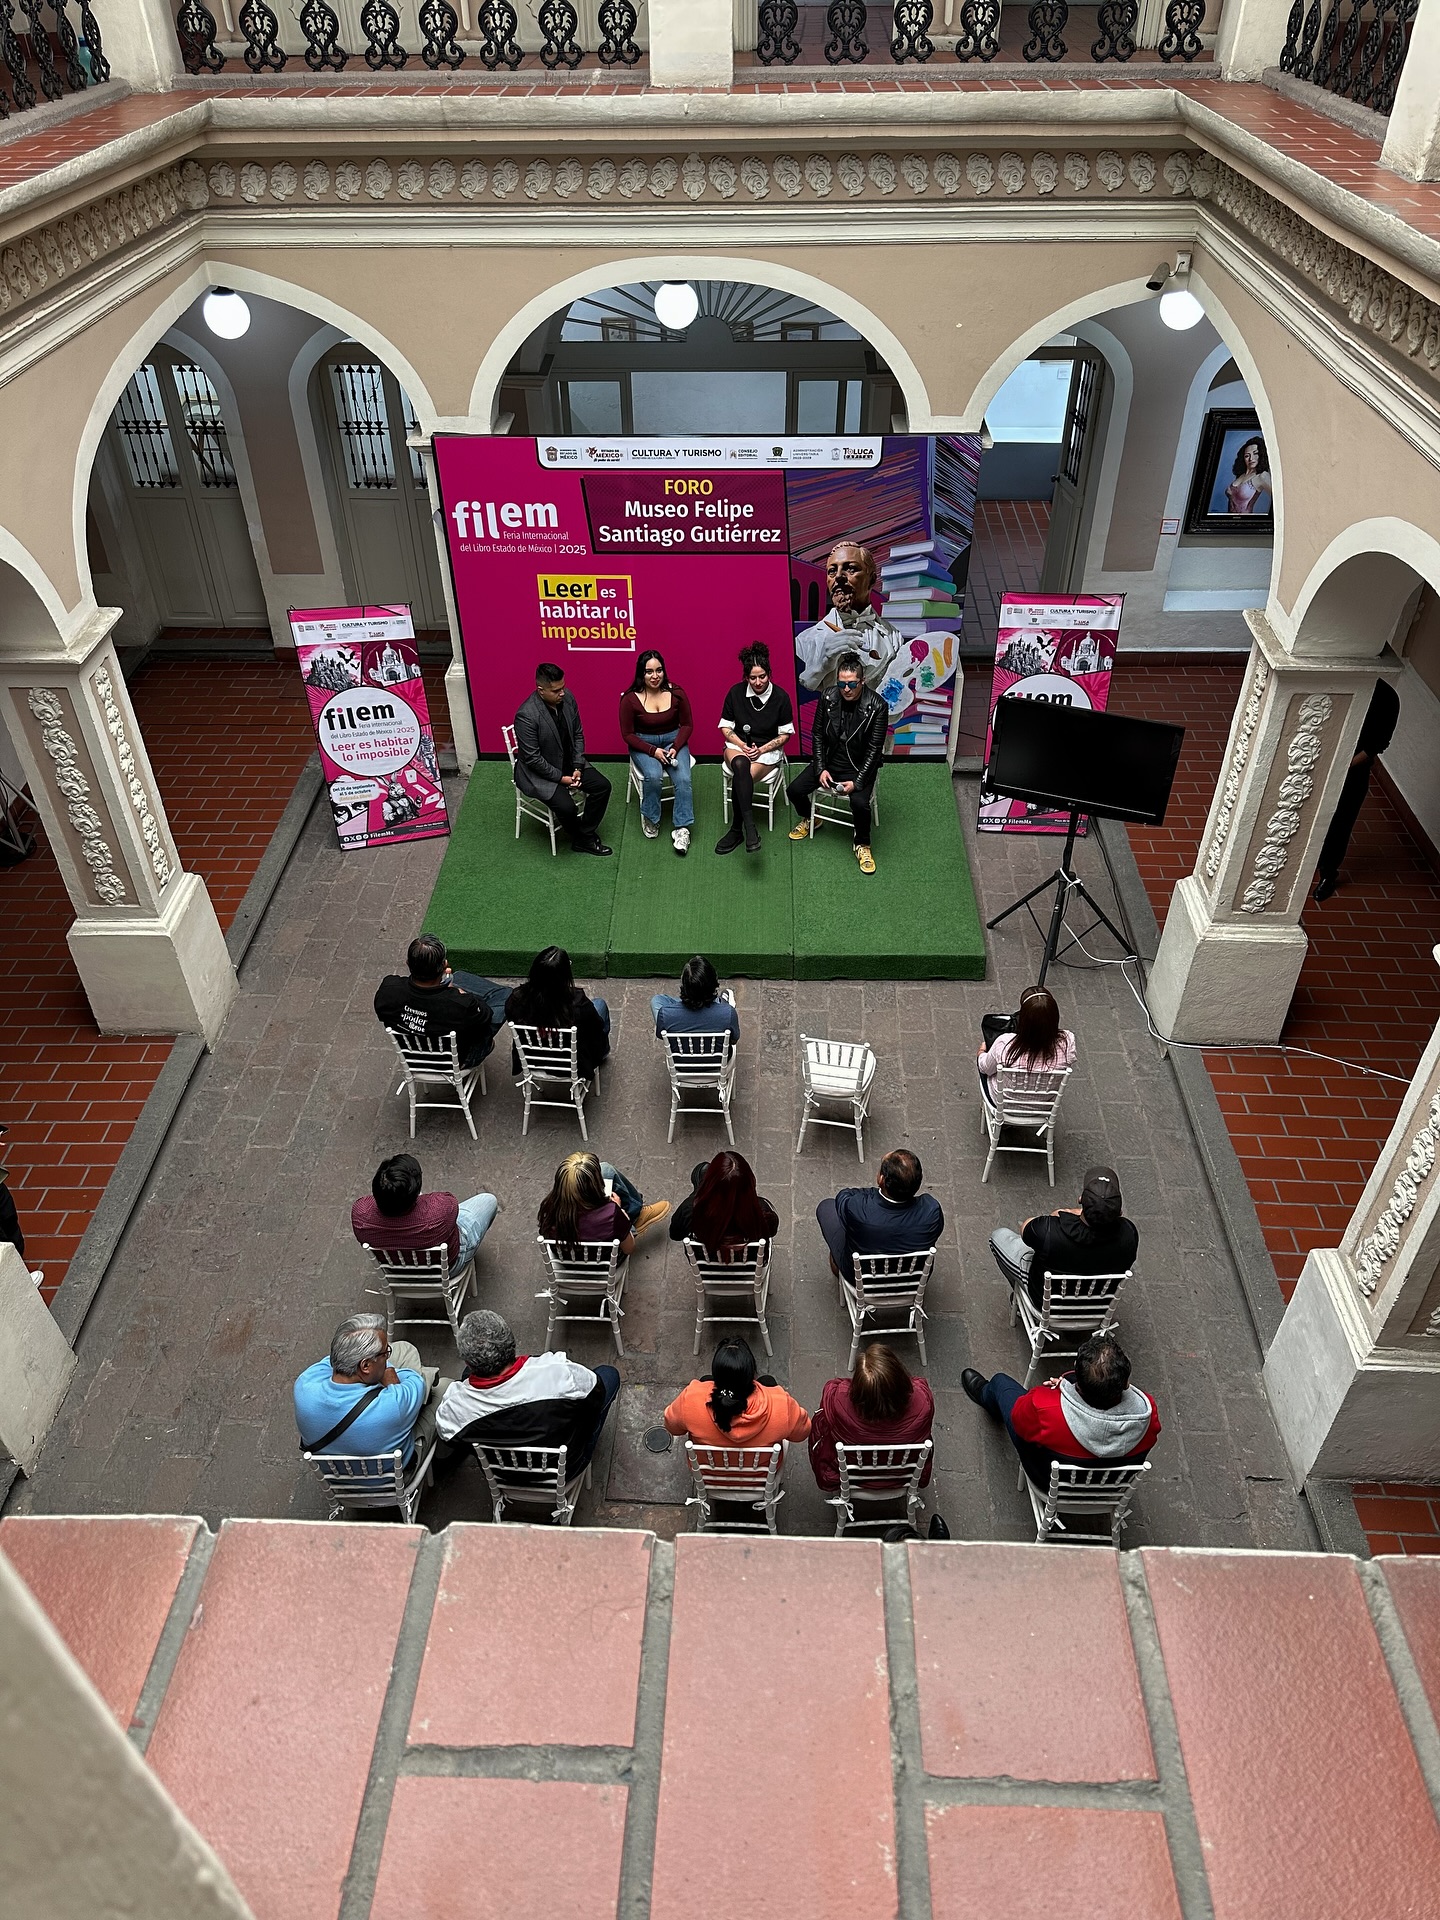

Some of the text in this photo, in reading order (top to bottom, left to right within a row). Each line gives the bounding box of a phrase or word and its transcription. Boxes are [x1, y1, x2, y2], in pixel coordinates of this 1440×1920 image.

[682, 449, 722, 457] TURISMO
[664, 479, 713, 495] FORO
[625, 499, 754, 522] Museo Felipe
[452, 500, 558, 539] filem
[503, 531, 569, 540] Feria Internacional
[599, 524, 781, 547] Santiago Gutiérrez
[460, 544, 586, 556] del Libro Estado de México 2025
[543, 580, 616, 598] Leer es
[540, 600, 628, 618] habitar lo
[541, 620, 637, 642] imposible
[324, 704, 395, 730] filem
[372, 720, 403, 728] Internacional
[331, 736, 414, 752] Leer es habitar
[342, 748, 410, 762] lo imposible
